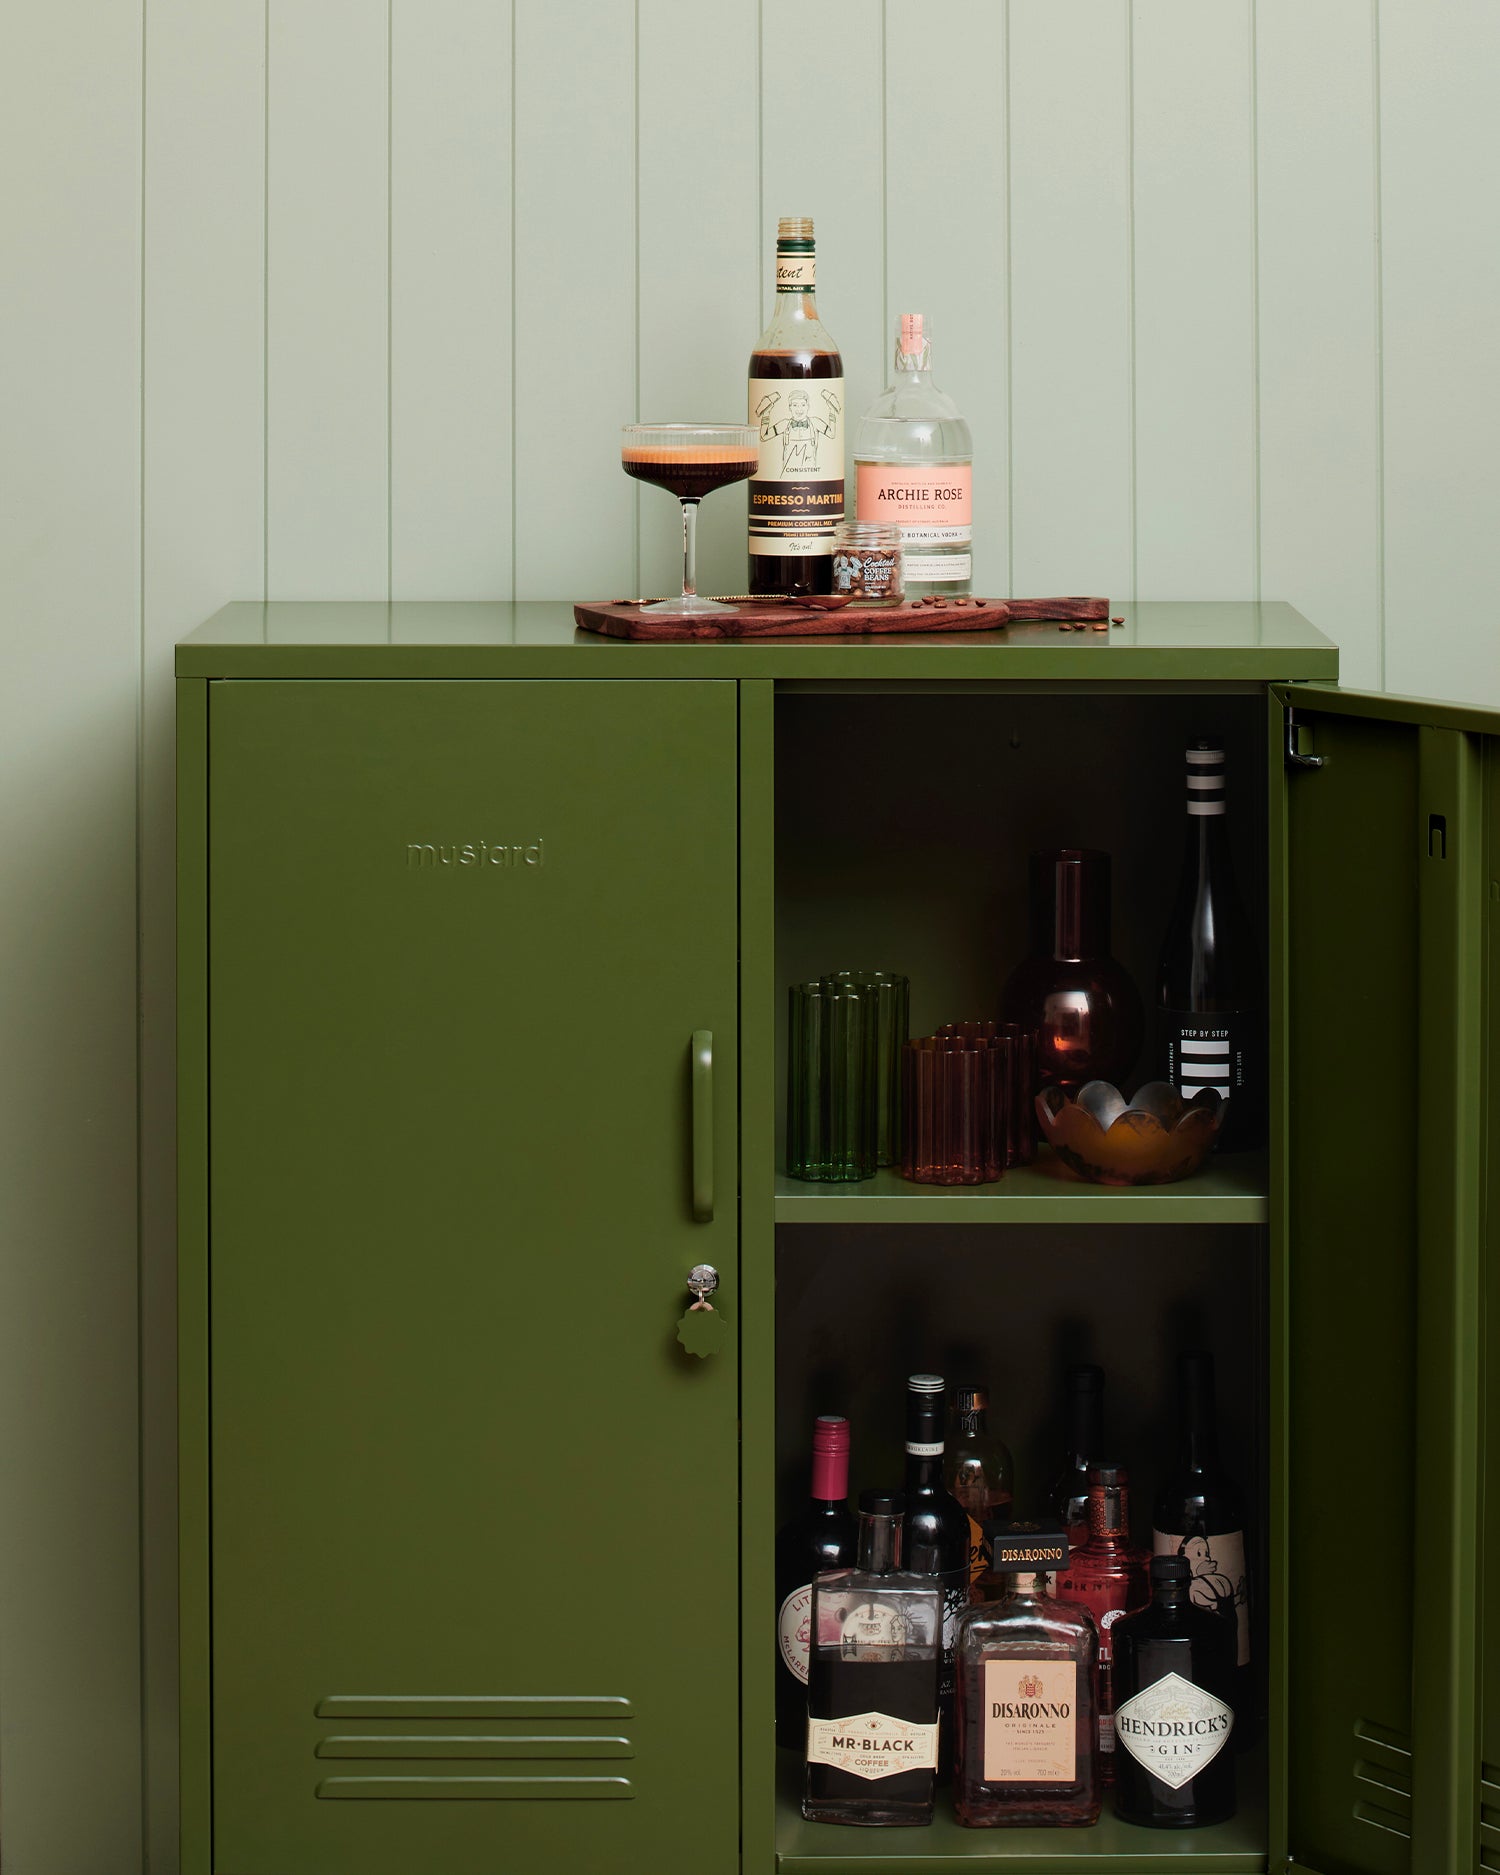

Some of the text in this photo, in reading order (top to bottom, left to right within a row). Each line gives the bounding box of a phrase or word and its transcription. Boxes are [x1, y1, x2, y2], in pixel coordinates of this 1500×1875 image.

[753, 494, 804, 505] ESPRESSO
[877, 488, 963, 501] ARCHIE ROSE
[794, 520, 822, 528] COCKTAIL
[864, 557, 895, 568] Cocktail
[406, 837, 545, 867] mustard
[1180, 1029, 1229, 1038] STEP BY STEP
[1001, 1547, 1063, 1562] DISARONNO
[992, 1702, 1071, 1720] DISARONNO
[1120, 1713, 1229, 1737] HENDRICK'S
[1158, 1744, 1194, 1756] GIN
[854, 1758, 889, 1767] COFFEE
